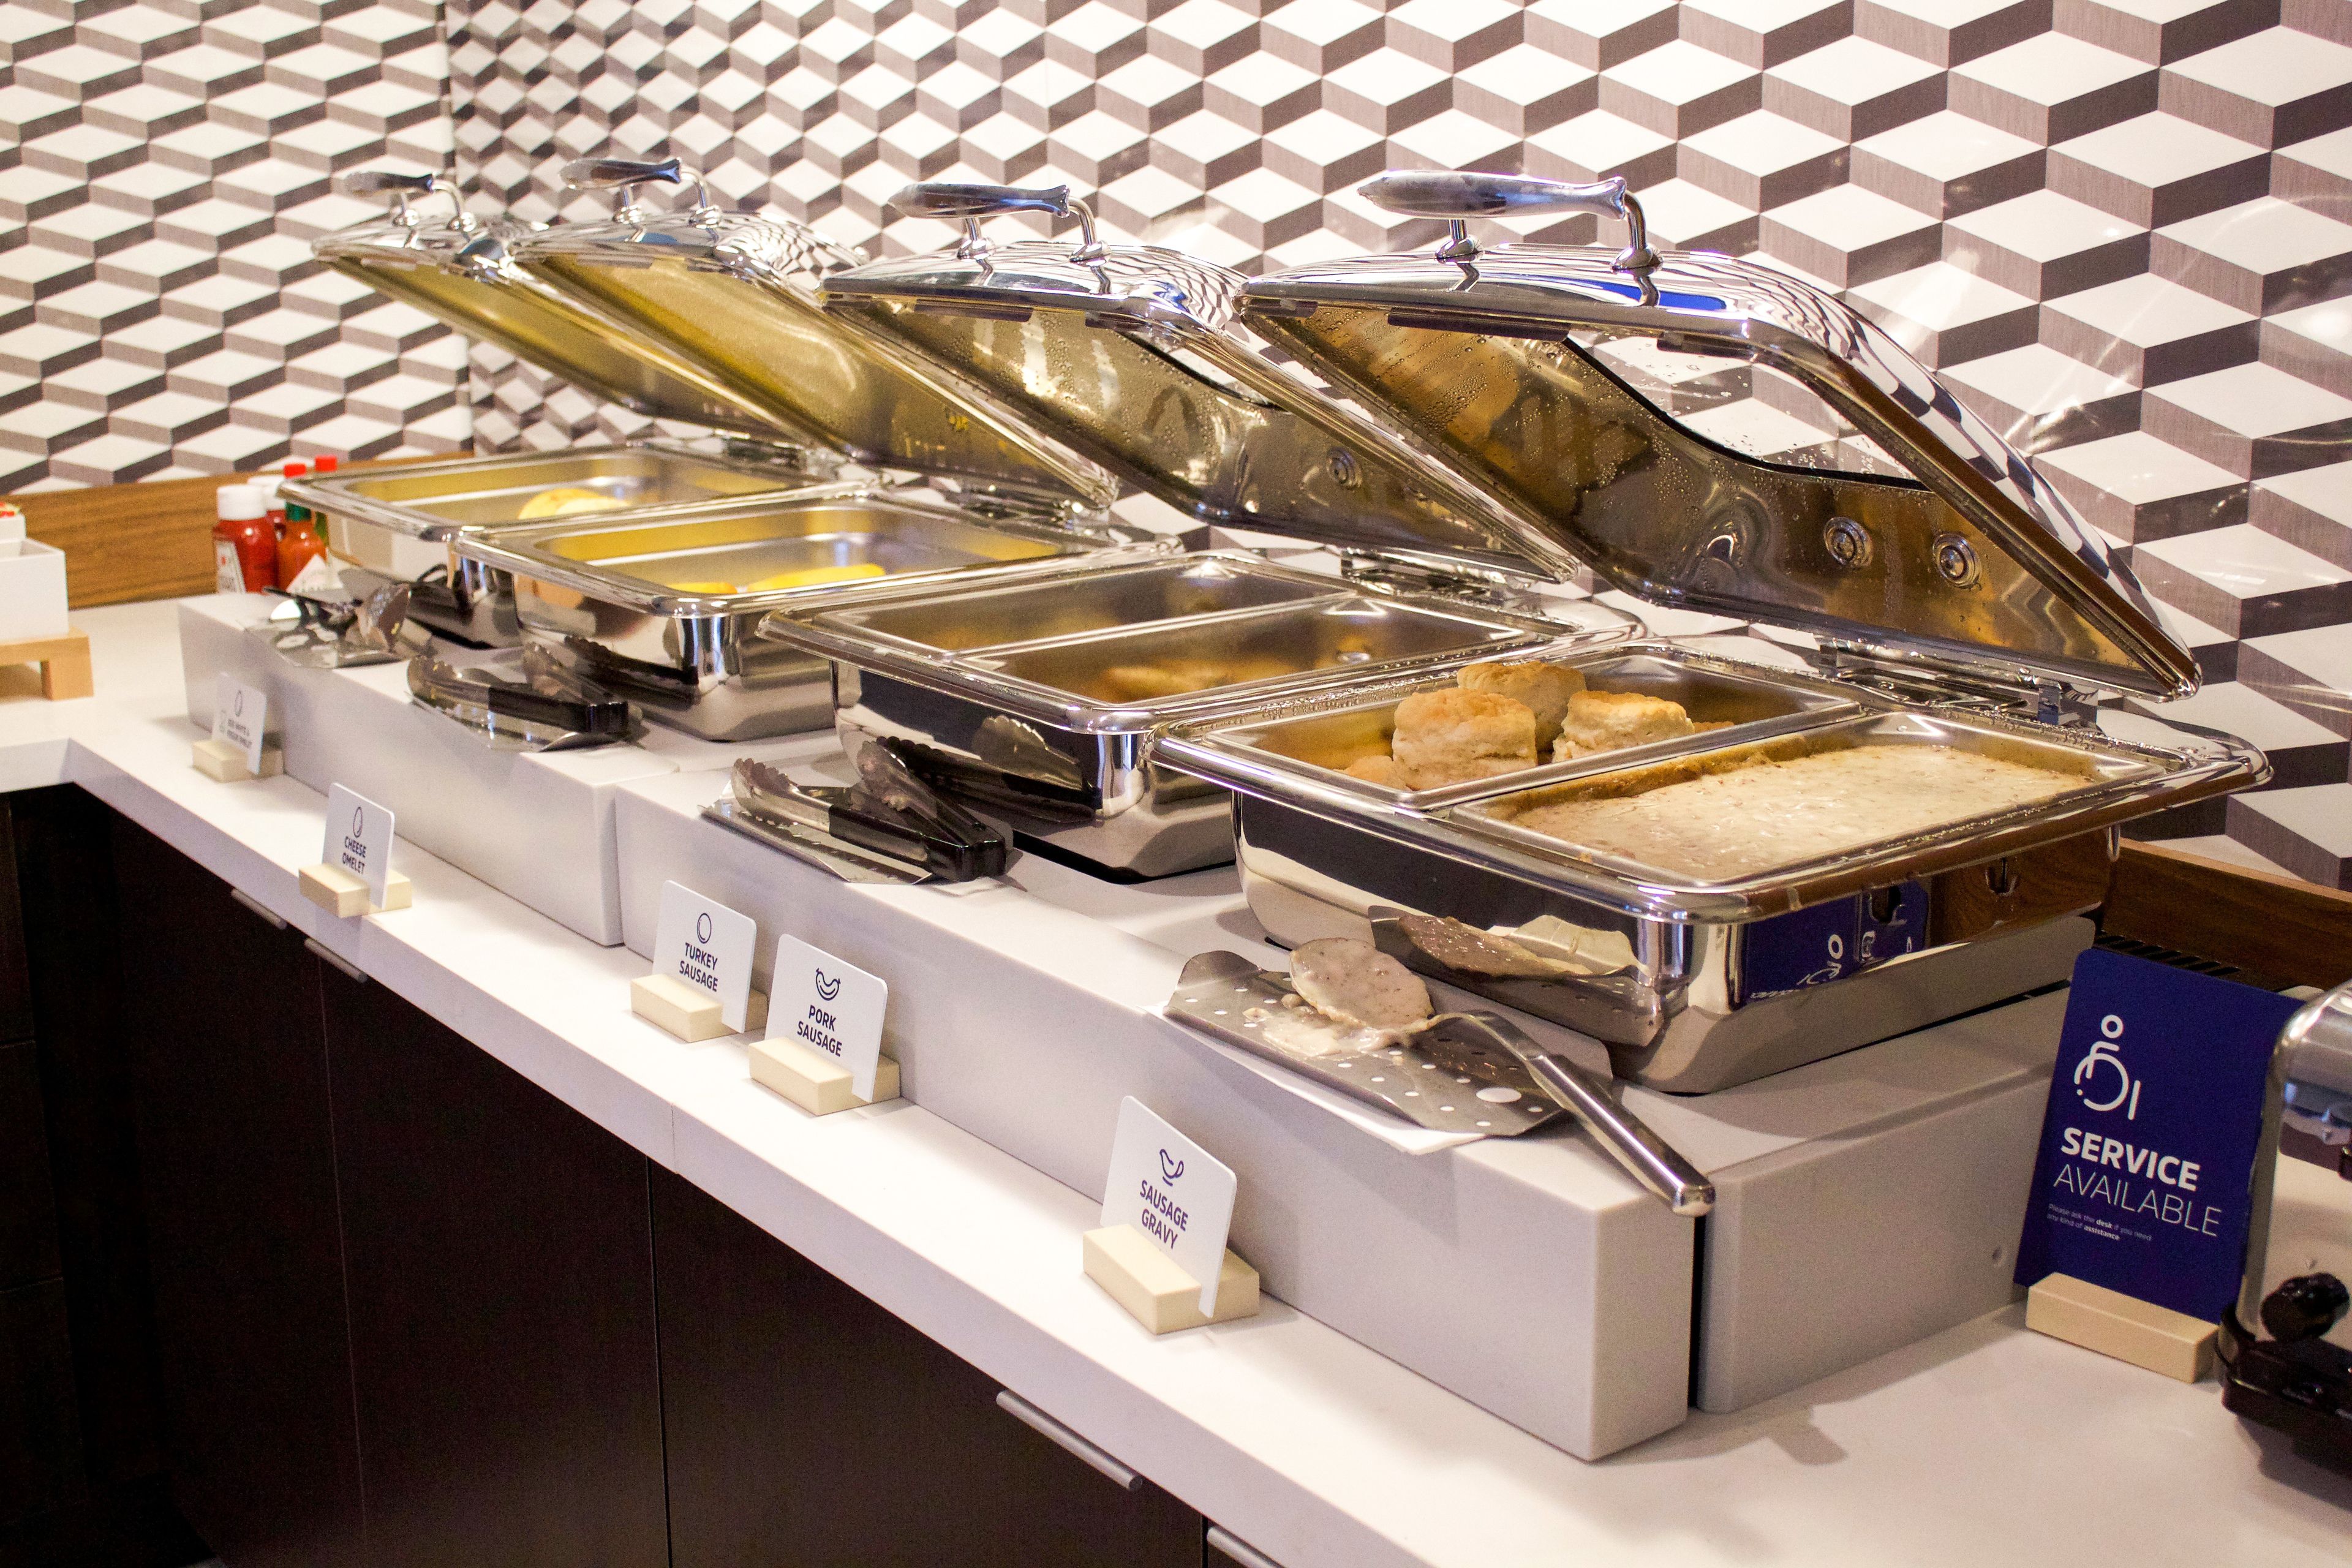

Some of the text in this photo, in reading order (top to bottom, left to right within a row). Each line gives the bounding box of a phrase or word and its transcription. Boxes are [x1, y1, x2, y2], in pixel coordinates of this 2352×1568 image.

[344, 836, 366, 858] CHEESE
[342, 853, 365, 875] OMELET
[685, 942, 718, 971] TURKEY
[679, 960, 718, 992] SAUSAGE
[809, 1005, 837, 1032] PORK
[797, 1020, 842, 1057] SAUSAGE
[2060, 1127, 2200, 1192] SERVICE
[1140, 1180, 1188, 1232] SAUSAGE
[2053, 1164, 2222, 1237] AVAILABLE
[1142, 1208, 1178, 1250] GRAVY
[2096, 1219, 2113, 1229] desk
